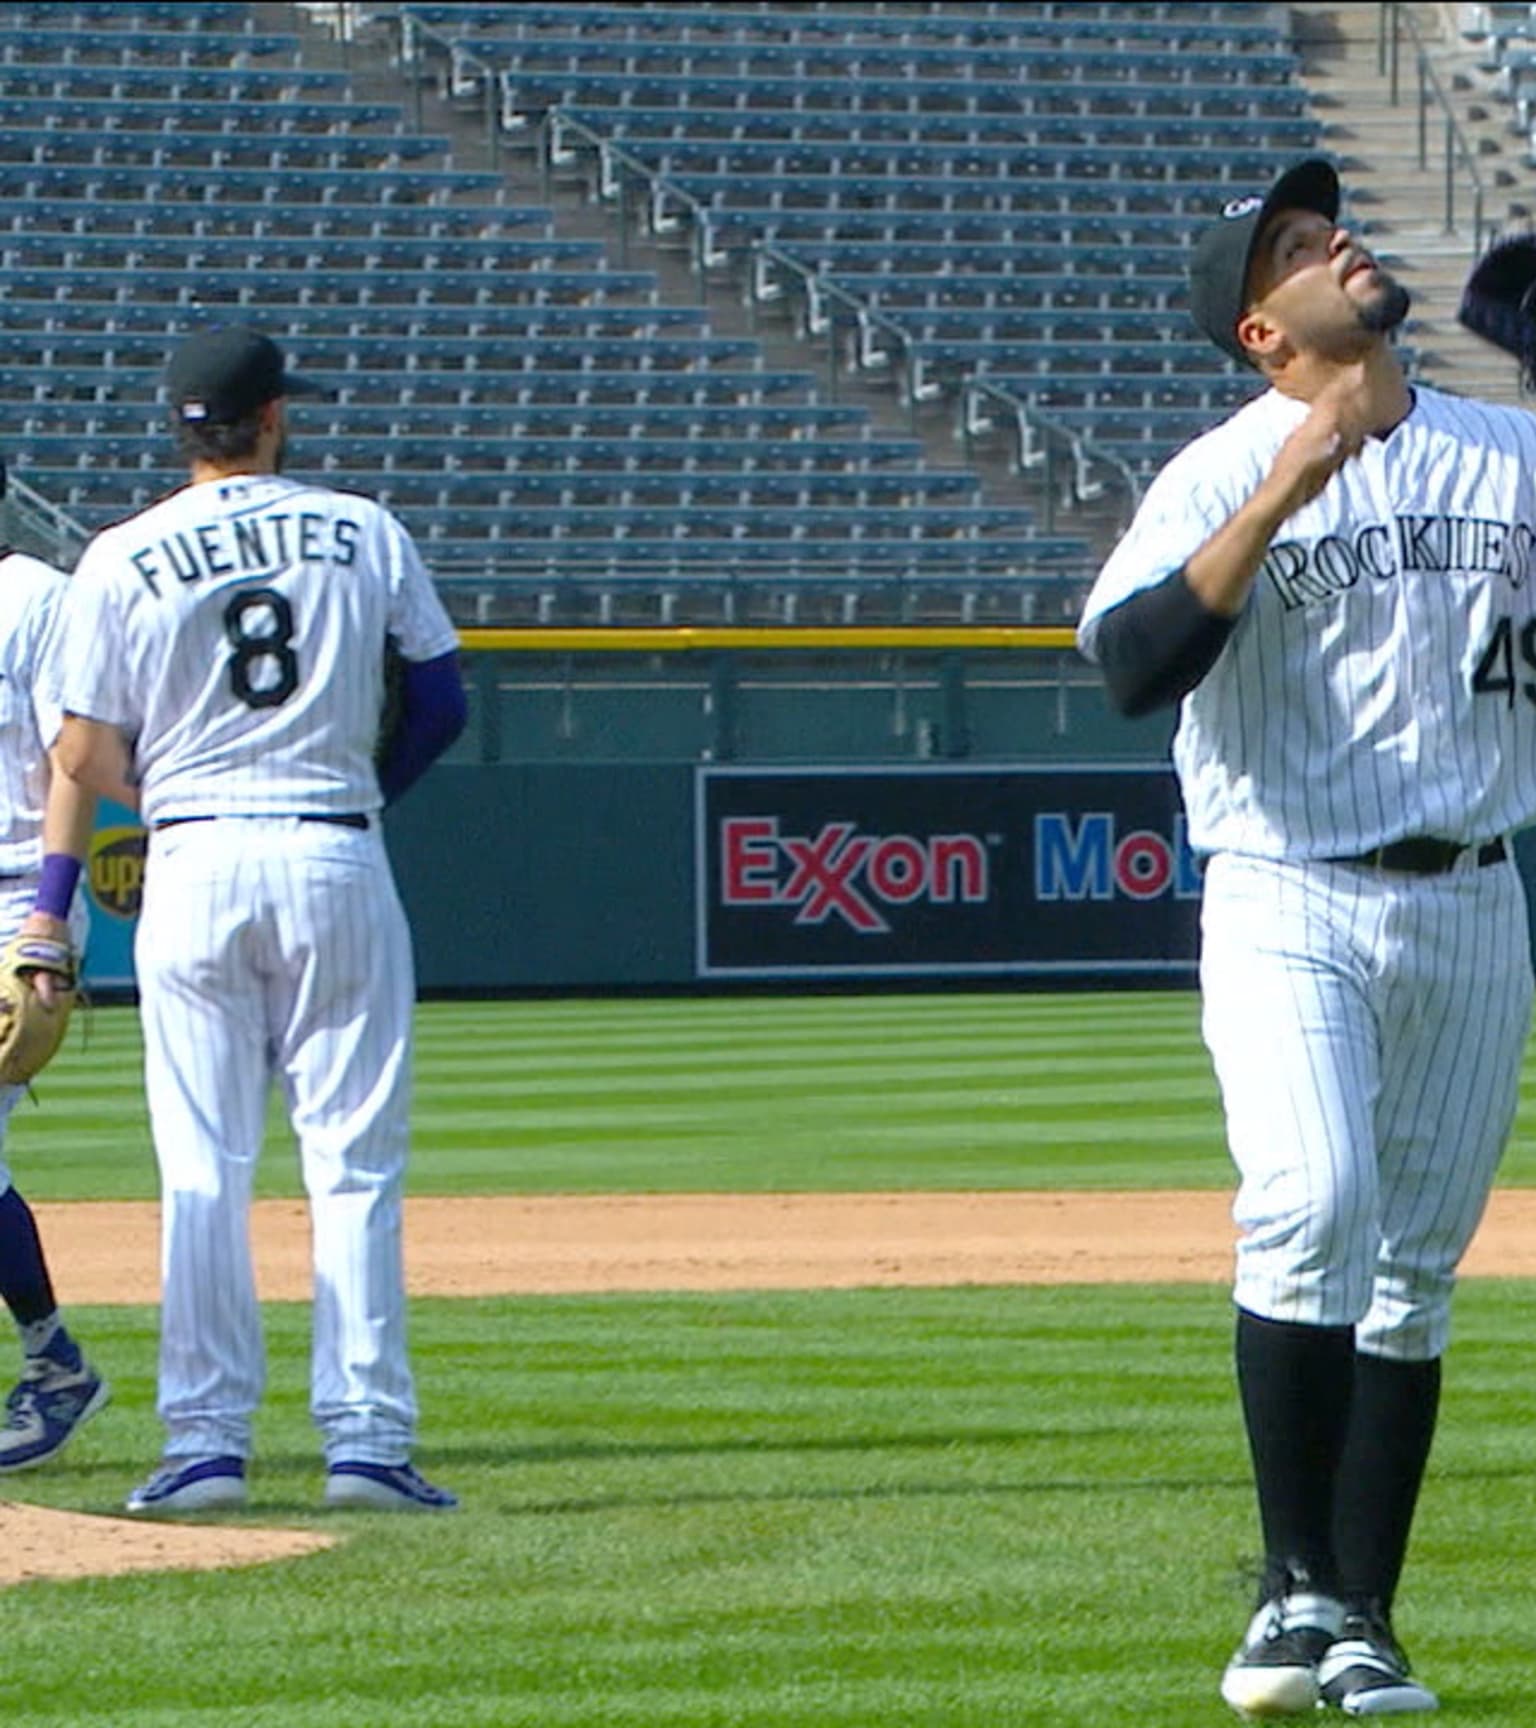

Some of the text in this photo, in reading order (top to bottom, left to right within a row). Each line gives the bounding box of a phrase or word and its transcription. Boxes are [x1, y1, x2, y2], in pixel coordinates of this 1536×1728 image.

[130, 512, 361, 599] FUENTES
[1263, 514, 1536, 613] ROCKIES
[223, 587, 300, 710] 8
[95, 854, 146, 906] up
[721, 816, 986, 932] Exxon
